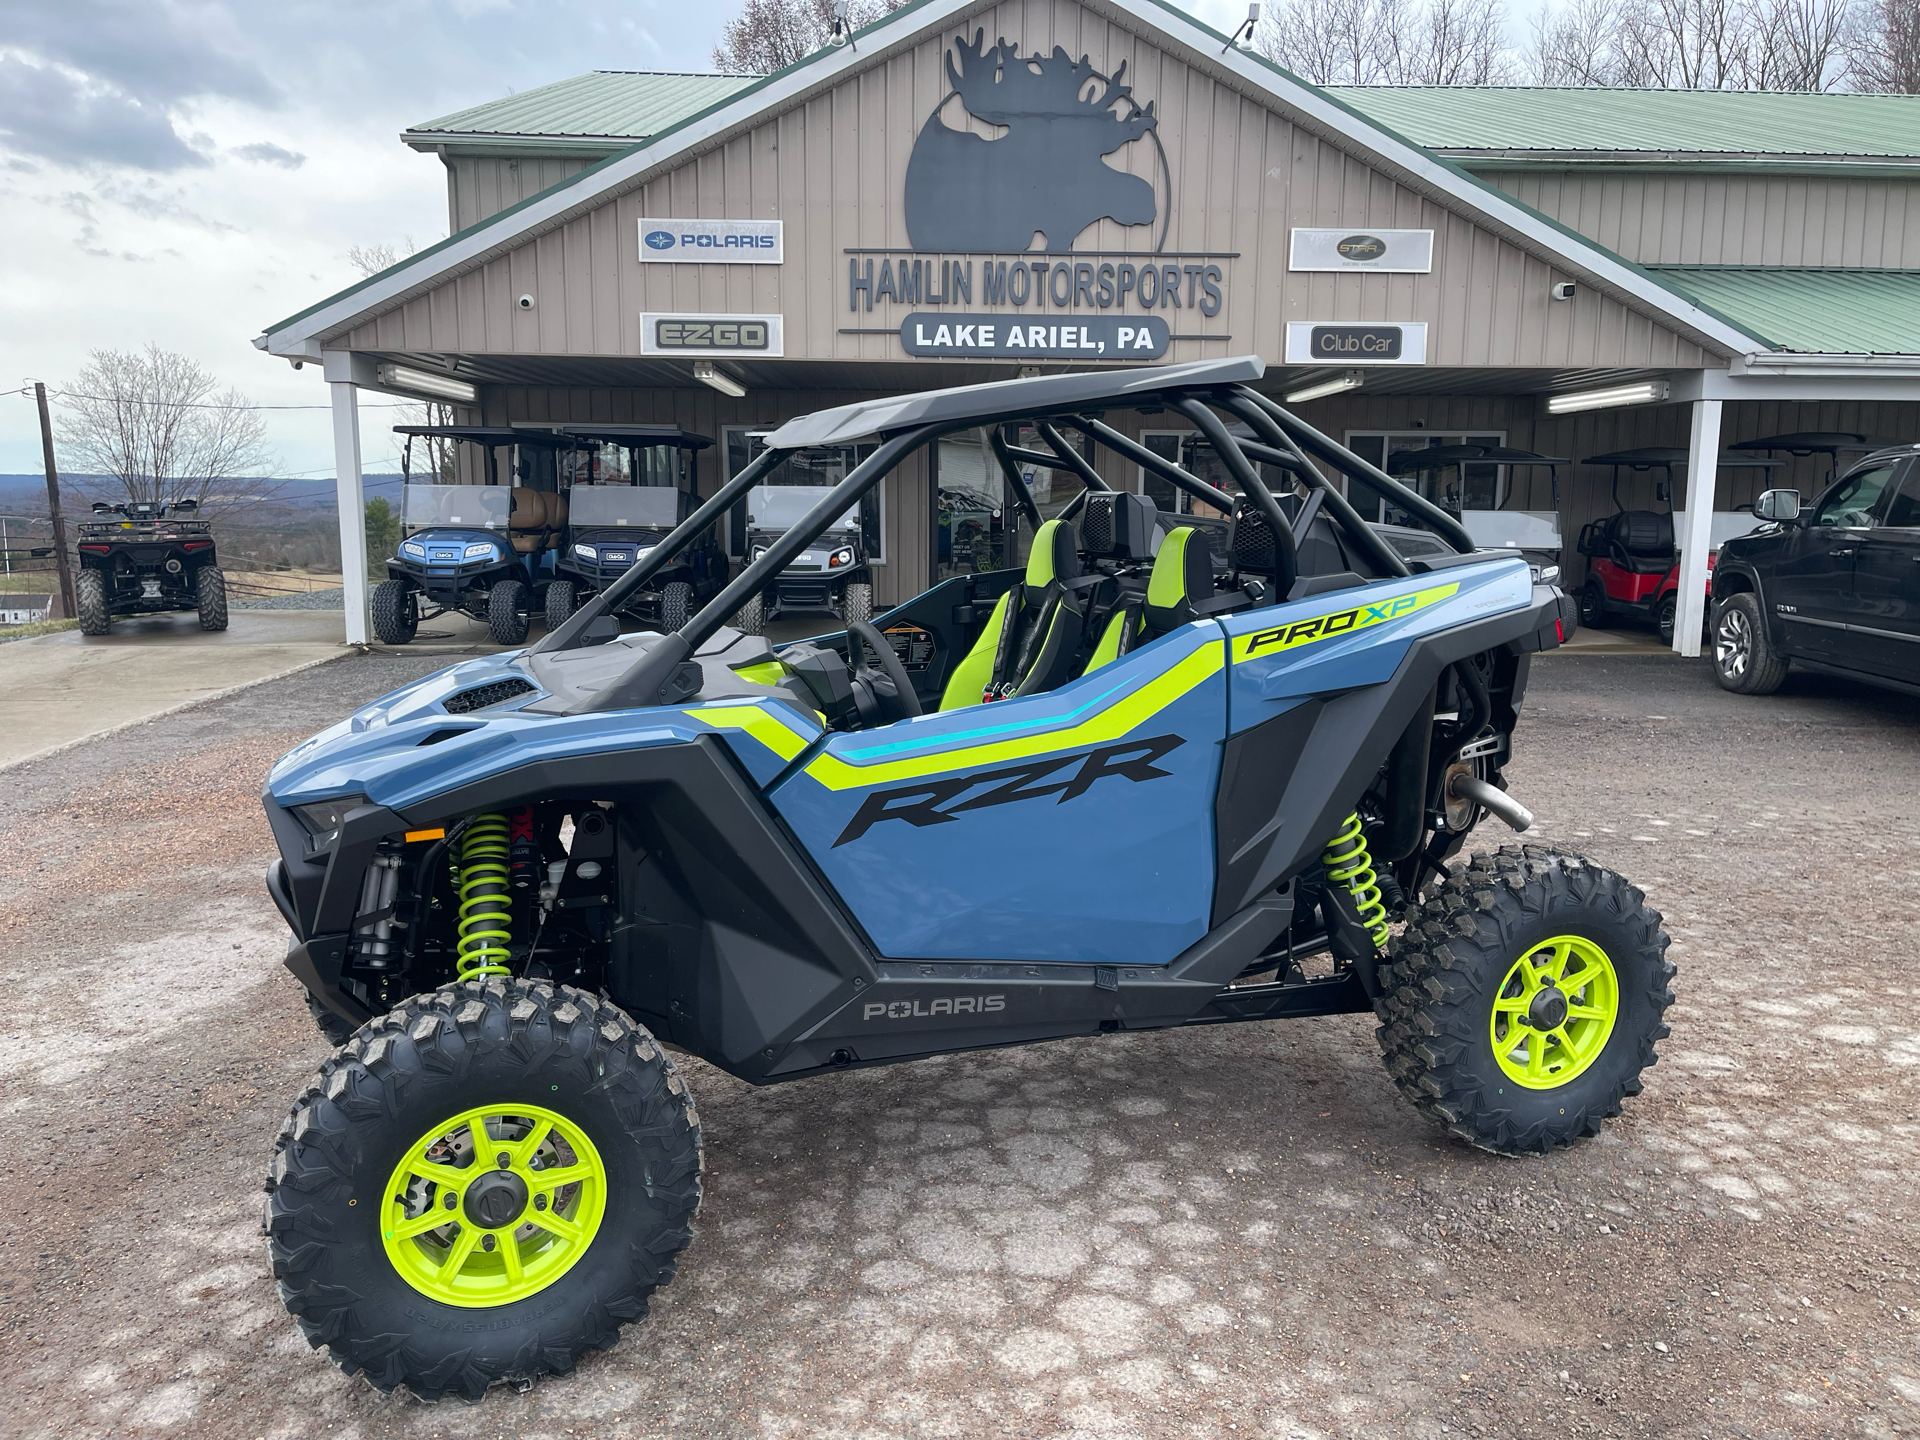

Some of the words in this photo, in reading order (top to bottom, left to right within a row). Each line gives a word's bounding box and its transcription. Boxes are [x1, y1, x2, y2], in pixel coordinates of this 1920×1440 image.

[681, 234, 775, 248] POLARIS
[850, 258, 972, 312] HAMLIN
[982, 261, 1222, 317] MOTORSPORTS
[916, 323, 995, 347] LAKE
[1005, 325, 1105, 354] ARIEL,
[1117, 327, 1154, 350] PA
[1320, 333, 1360, 352] Club
[1361, 334, 1393, 352] Car
[1776, 603, 1798, 613] RAM
[1245, 609, 1360, 655] PRO
[1359, 596, 1417, 626] XP
[830, 733, 1188, 849] RZR
[863, 995, 1006, 1021] POLARIS
